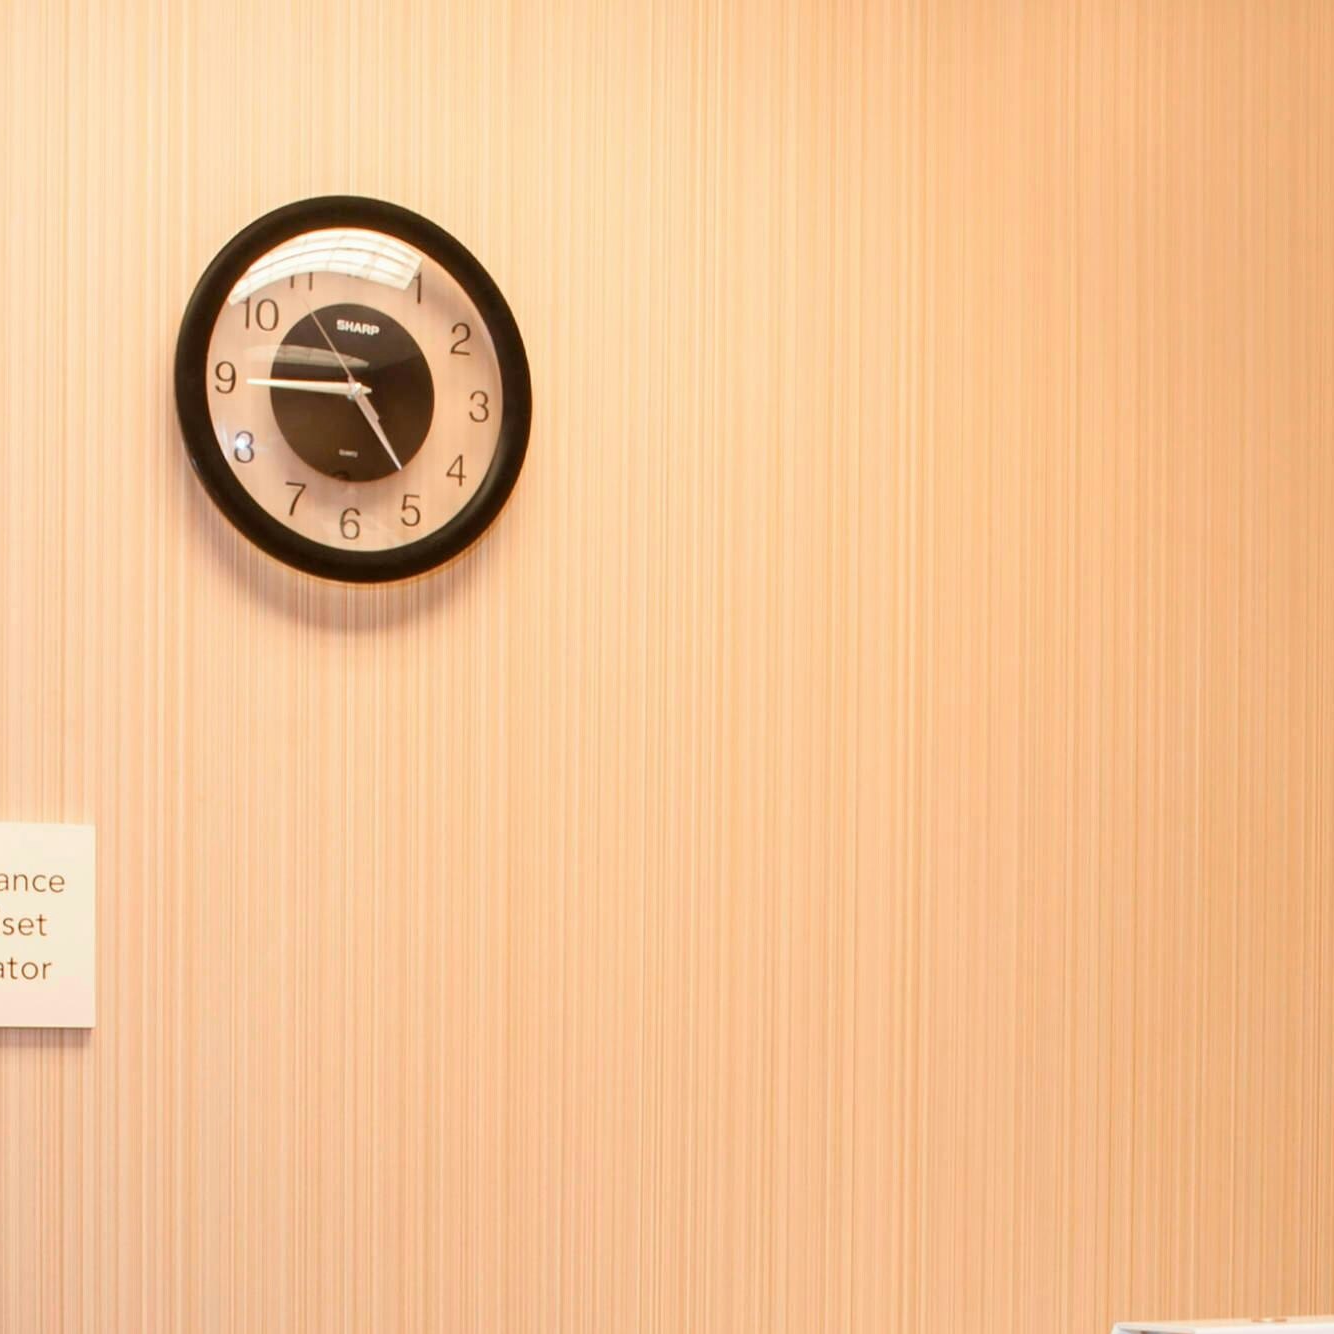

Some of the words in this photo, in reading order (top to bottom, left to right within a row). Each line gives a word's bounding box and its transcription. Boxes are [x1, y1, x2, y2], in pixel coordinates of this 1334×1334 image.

[412, 271, 422, 305] 1
[240, 297, 280, 332] 10
[336, 319, 380, 336] SHARP
[450, 322, 472, 356] 2
[214, 361, 237, 394] 9
[468, 390, 490, 423] 3
[233, 430, 255, 463] 8
[445, 454, 468, 487] 4
[285, 481, 307, 516] 7
[400, 494, 421, 527] 5
[339, 507, 362, 540] 6
